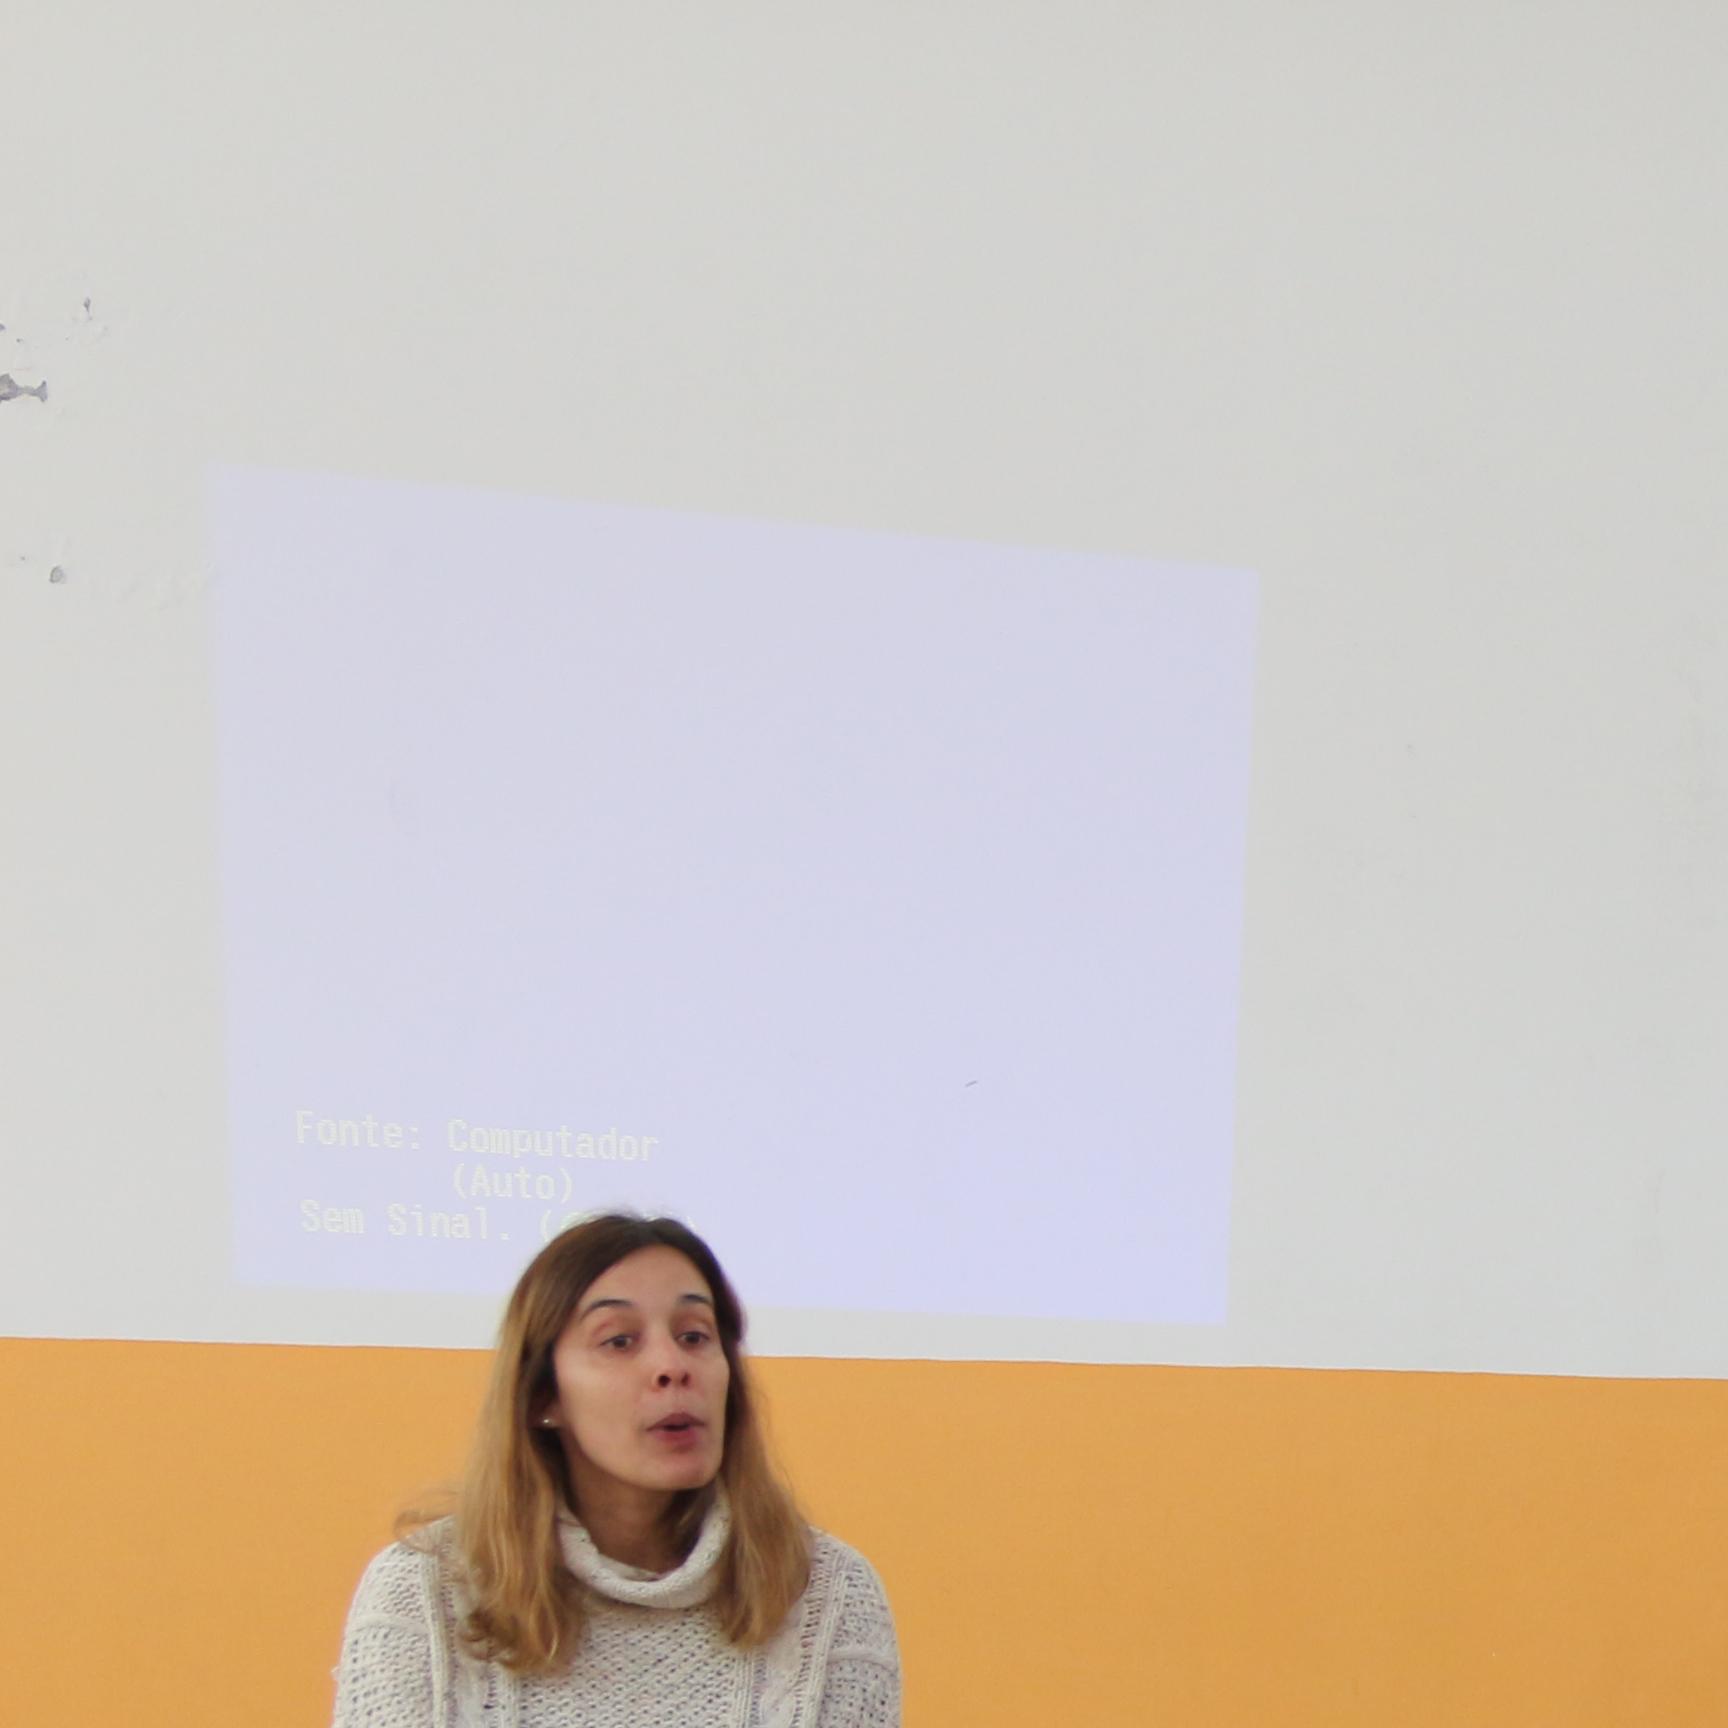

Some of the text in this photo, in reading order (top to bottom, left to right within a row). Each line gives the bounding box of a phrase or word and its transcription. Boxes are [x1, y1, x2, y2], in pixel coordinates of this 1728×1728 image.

[295, 1109, 660, 1162] Fonte: Computador
[453, 1162, 573, 1204] (Auto)
[301, 1199, 366, 1235] Sem
